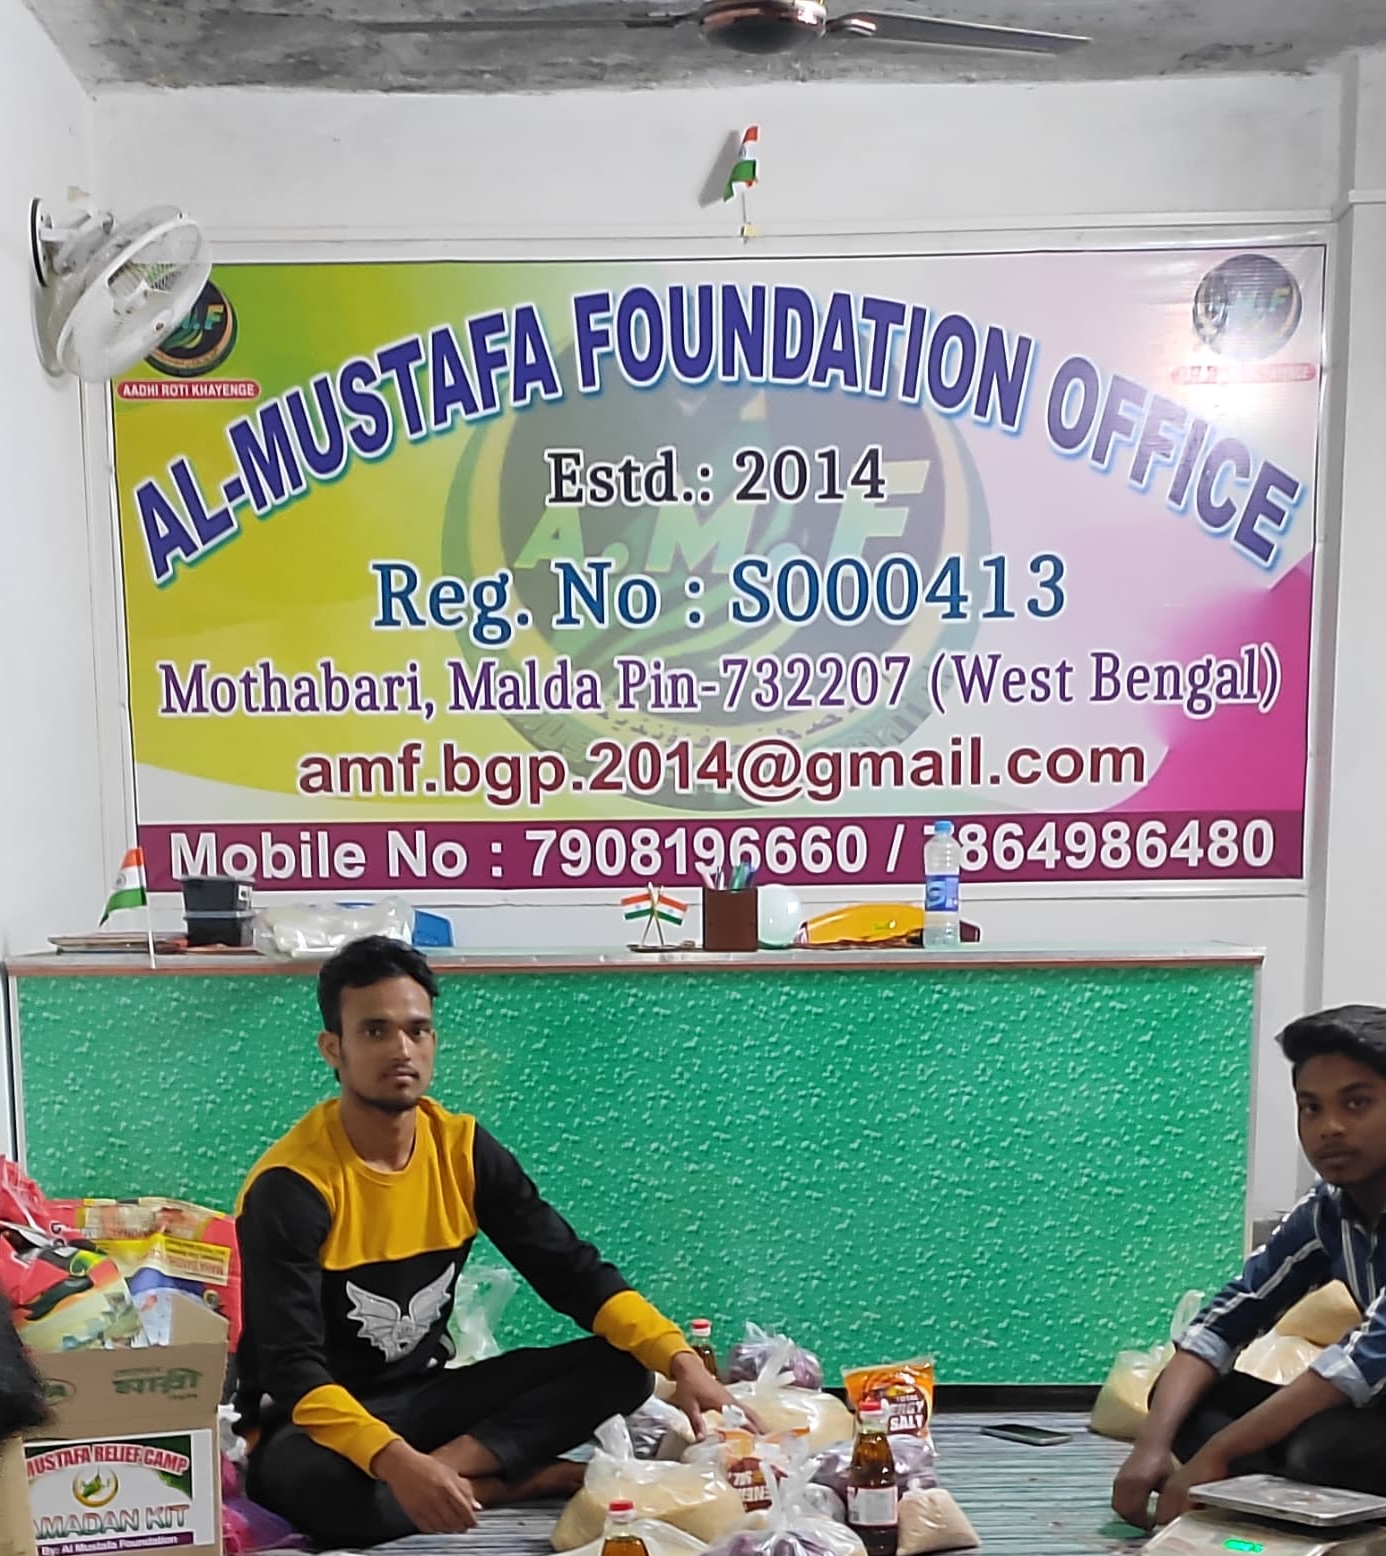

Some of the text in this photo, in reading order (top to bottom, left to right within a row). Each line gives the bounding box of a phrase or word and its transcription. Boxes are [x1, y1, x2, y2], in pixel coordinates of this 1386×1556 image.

[123, 383, 255, 397] AADHI ROTI KHAYENGE
[135, 285, 1300, 579] AL-MUSTAFA FOUNDATION OFFICE
[547, 448, 885, 502] Estd.: 2014
[372, 554, 1067, 645] Reg. No : S000413
[159, 646, 1282, 720] Mothabari, Malda Pin-732207 (West Bengal)
[299, 735, 1146, 807] amf.bgp.2014@gmail.com
[170, 830, 367, 879] Mobile
[387, 829, 469, 879] No
[491, 840, 503, 878] :
[525, 824, 868, 878] 7908196660
[886, 824, 905, 873] /
[889, 1414, 924, 1432] SALT
[95, 1445, 141, 1463] RELIEF
[143, 1447, 189, 1474] CAMP
[75, 1540, 117, 1553] Mustafa
[119, 1534, 178, 1549] Foundation
[146, 1504, 190, 1530] KIT
